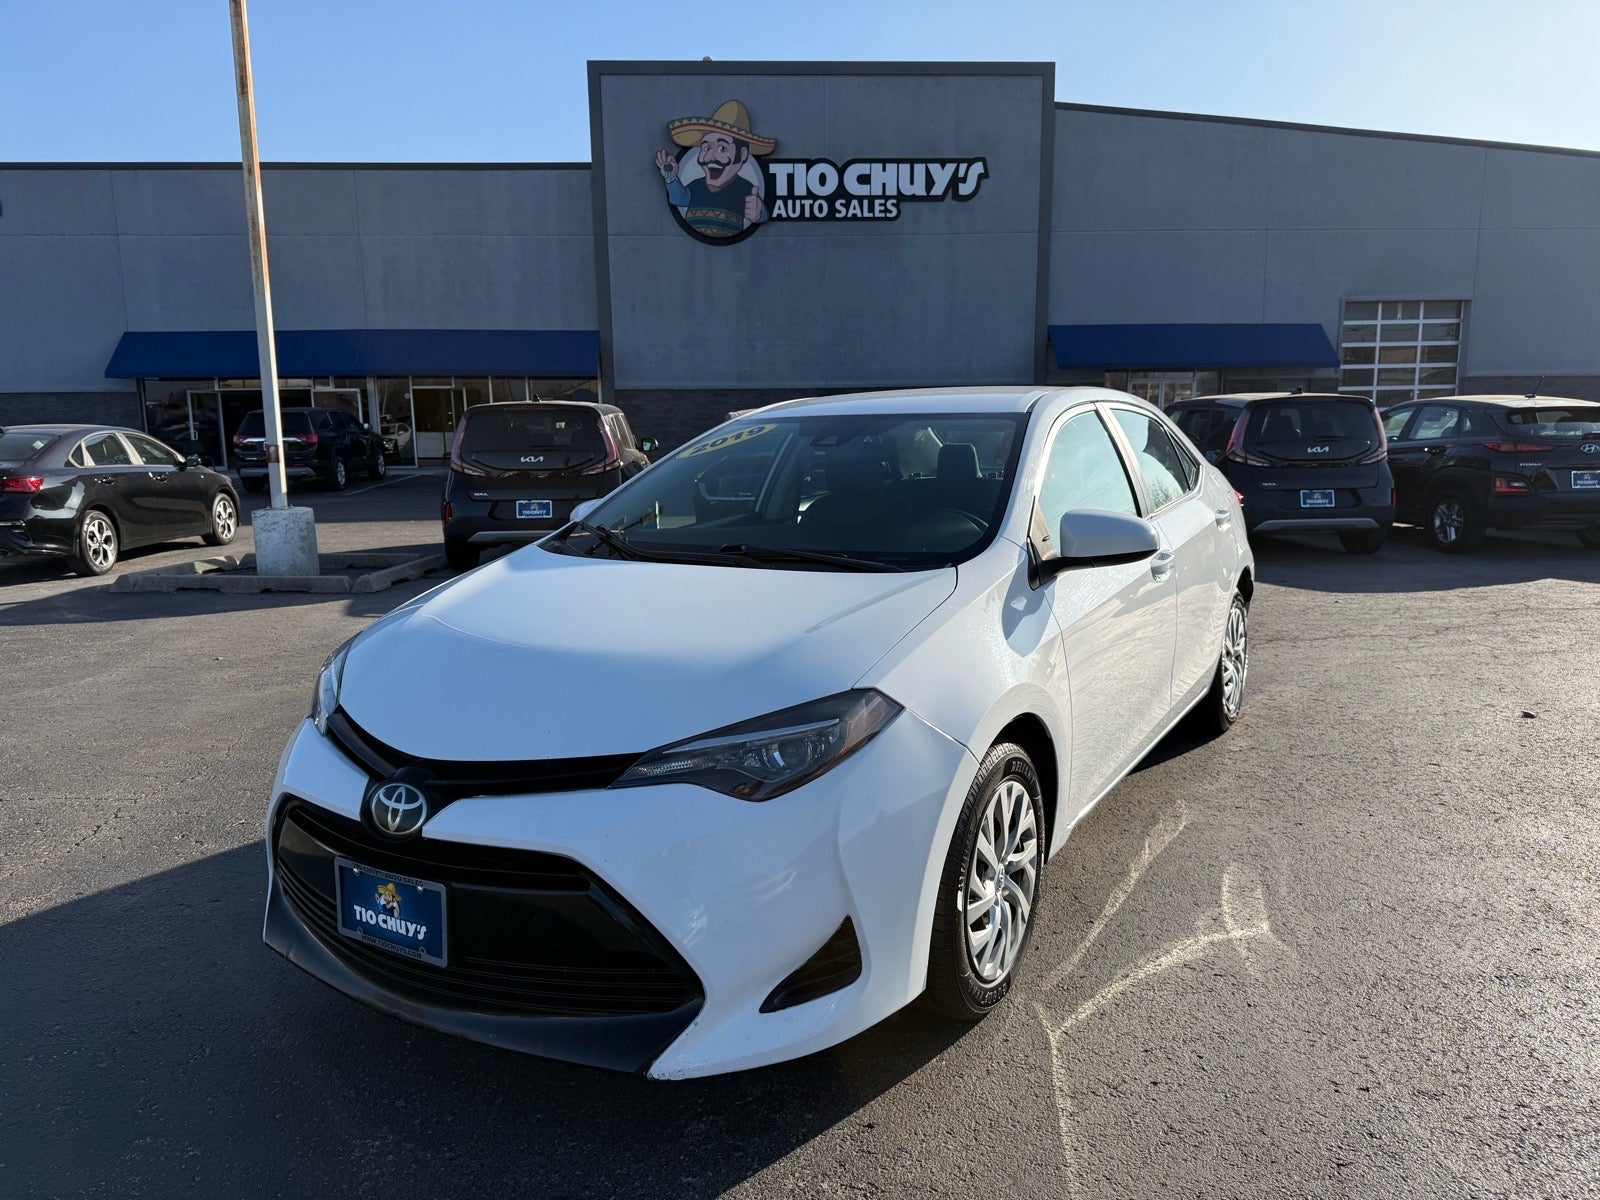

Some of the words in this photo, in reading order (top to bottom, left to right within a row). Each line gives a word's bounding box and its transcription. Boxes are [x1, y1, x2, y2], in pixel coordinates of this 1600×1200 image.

[769, 163, 839, 197] TIO
[843, 161, 985, 197] CHUY'S
[772, 199, 828, 218] AUTO
[835, 199, 897, 218] SALES
[688, 426, 765, 455] 2019
[353, 904, 377, 926] TIO
[377, 912, 428, 940] CHUY'S
